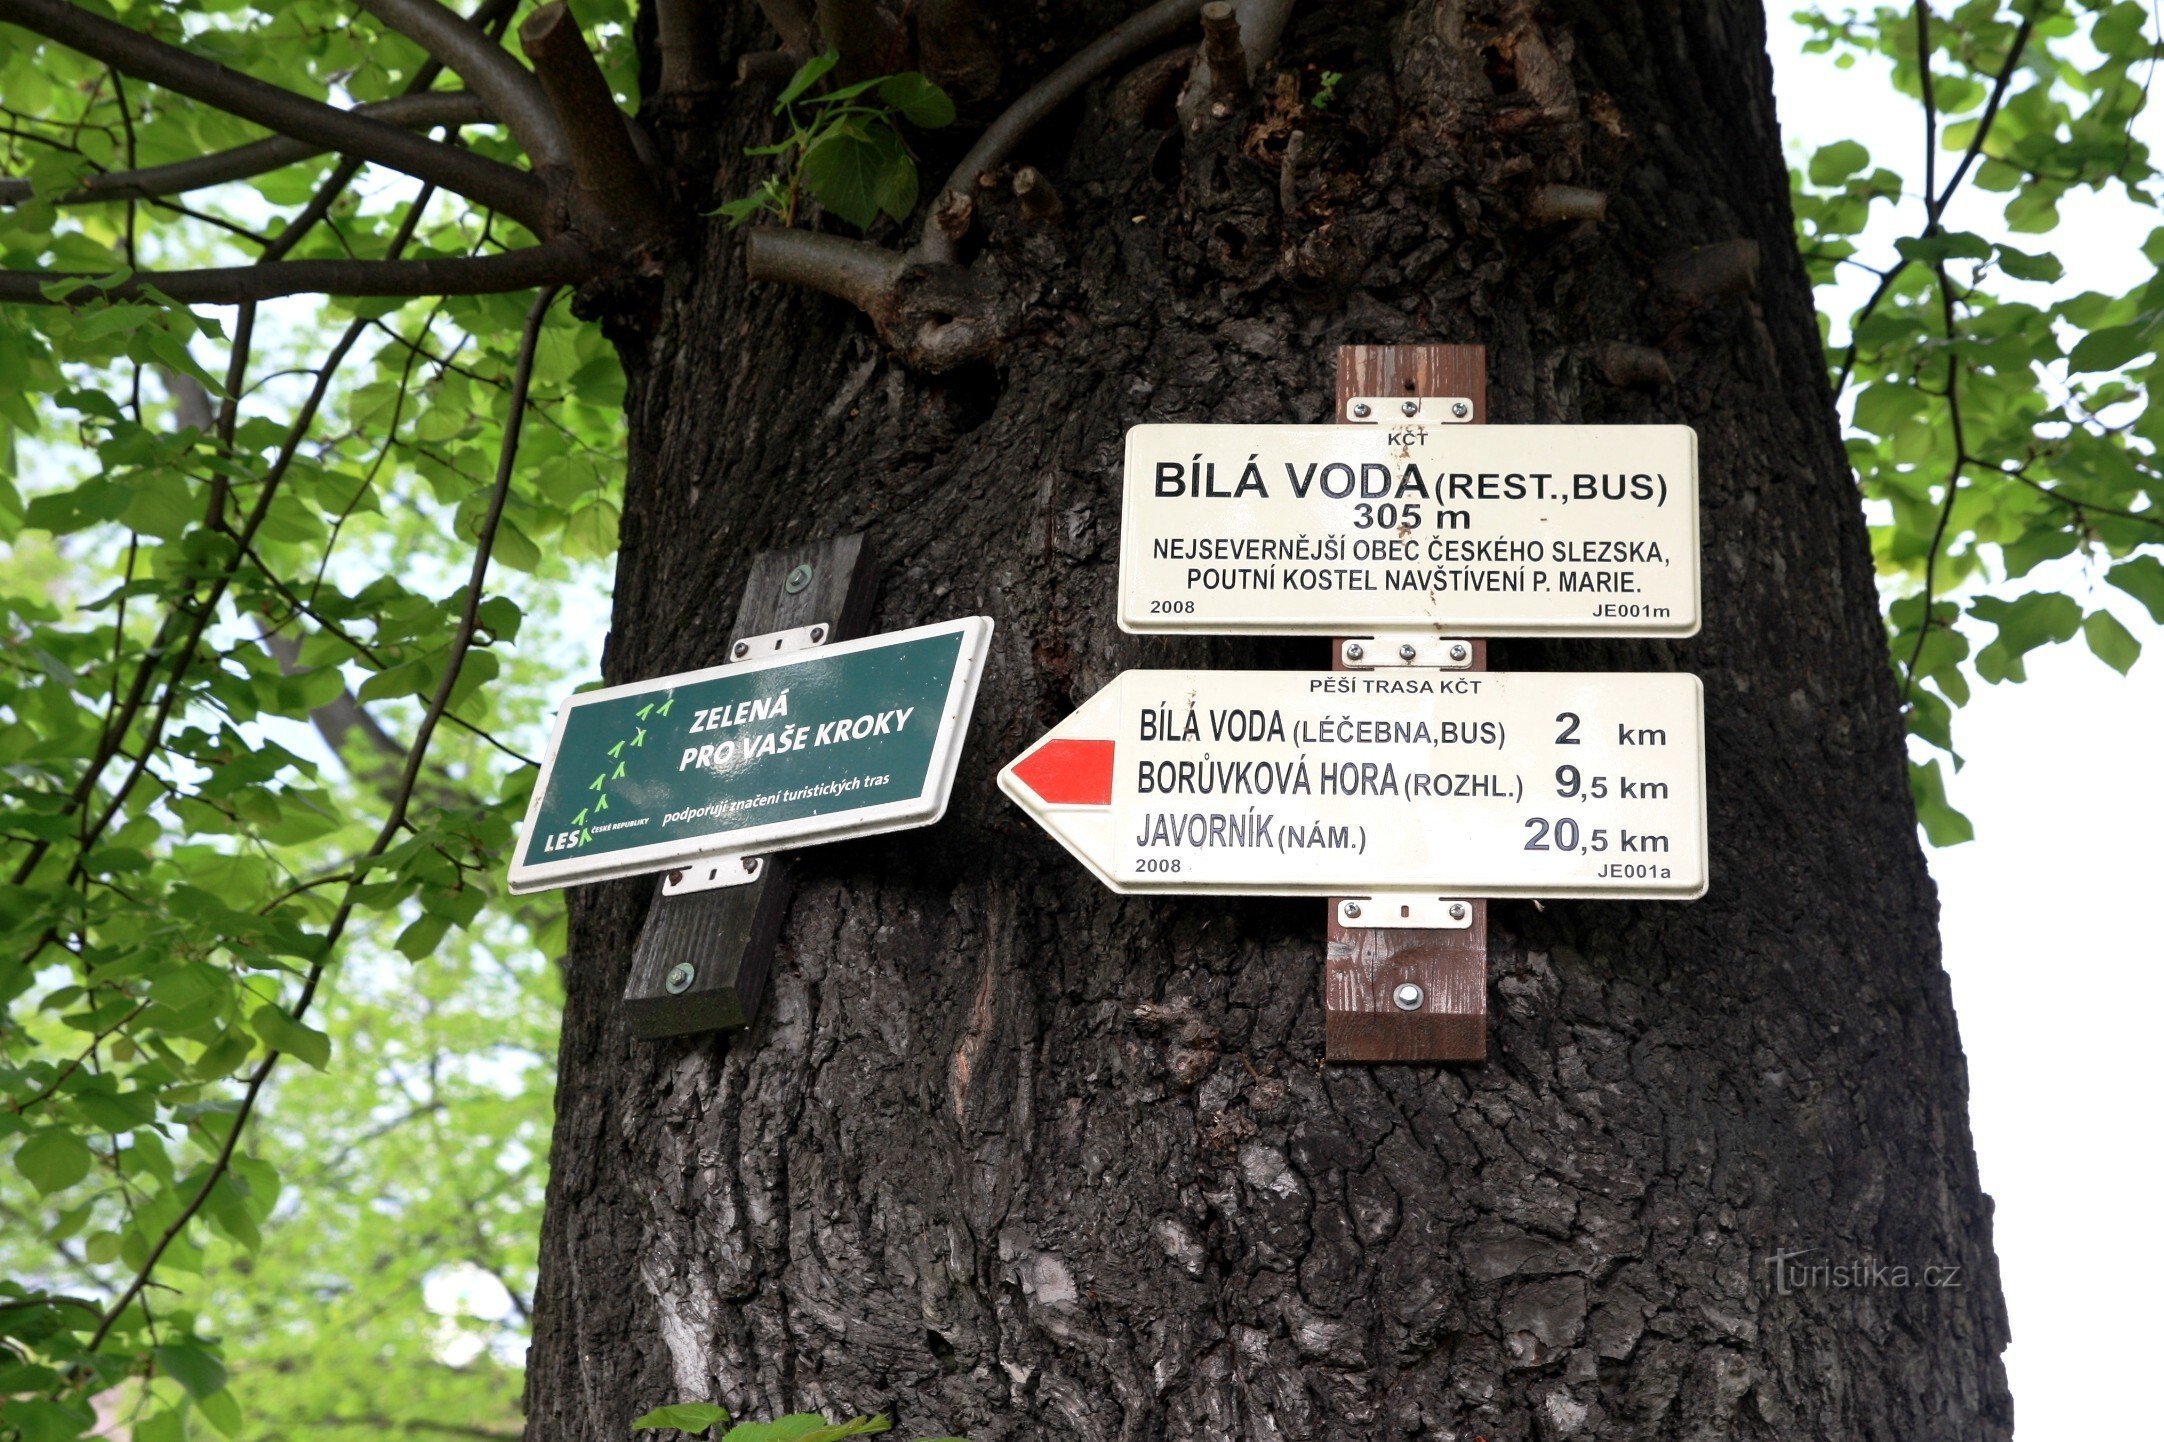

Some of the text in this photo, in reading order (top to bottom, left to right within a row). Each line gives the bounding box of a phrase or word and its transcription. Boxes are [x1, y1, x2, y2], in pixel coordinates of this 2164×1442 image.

[1388, 430, 1428, 446] KČT
[1155, 453, 1269, 498] BÍLÁ
[1353, 503, 1470, 530] 305 m
[1153, 534, 1670, 567] NEJSEVERNĚJŠÍ OBEC ČESKÉHO SLEZSKA,
[1187, 564, 1641, 593] POUTNÍ KOSTEL NAVŠTÍVENÍ P. MARIE.
[1150, 600, 1195, 614] 2008
[1592, 604, 1670, 618] JE001m
[1310, 676, 1482, 694] PĚŠÍ TRASA KČT
[689, 688, 790, 733] ZELENÁ
[1140, 701, 1200, 741] BÍLÁ
[1209, 709, 1285, 742] VODA
[1555, 711, 1581, 745] 2
[1618, 723, 1666, 745] km
[679, 706, 915, 772] PRO VAŠE KROKY
[1138, 752, 1311, 795] BORŮVKOVÁ
[1555, 764, 1608, 802] 9,5
[1620, 777, 1668, 799] km
[662, 773, 890, 827] podporují značení turistických tras
[591, 817, 649, 834] ČESKÉ REPUBLIKY
[1524, 817, 1608, 855] 20,5
[1621, 829, 1669, 852] km
[1135, 859, 1181, 873] 2008
[1598, 864, 1671, 879] JE001a
